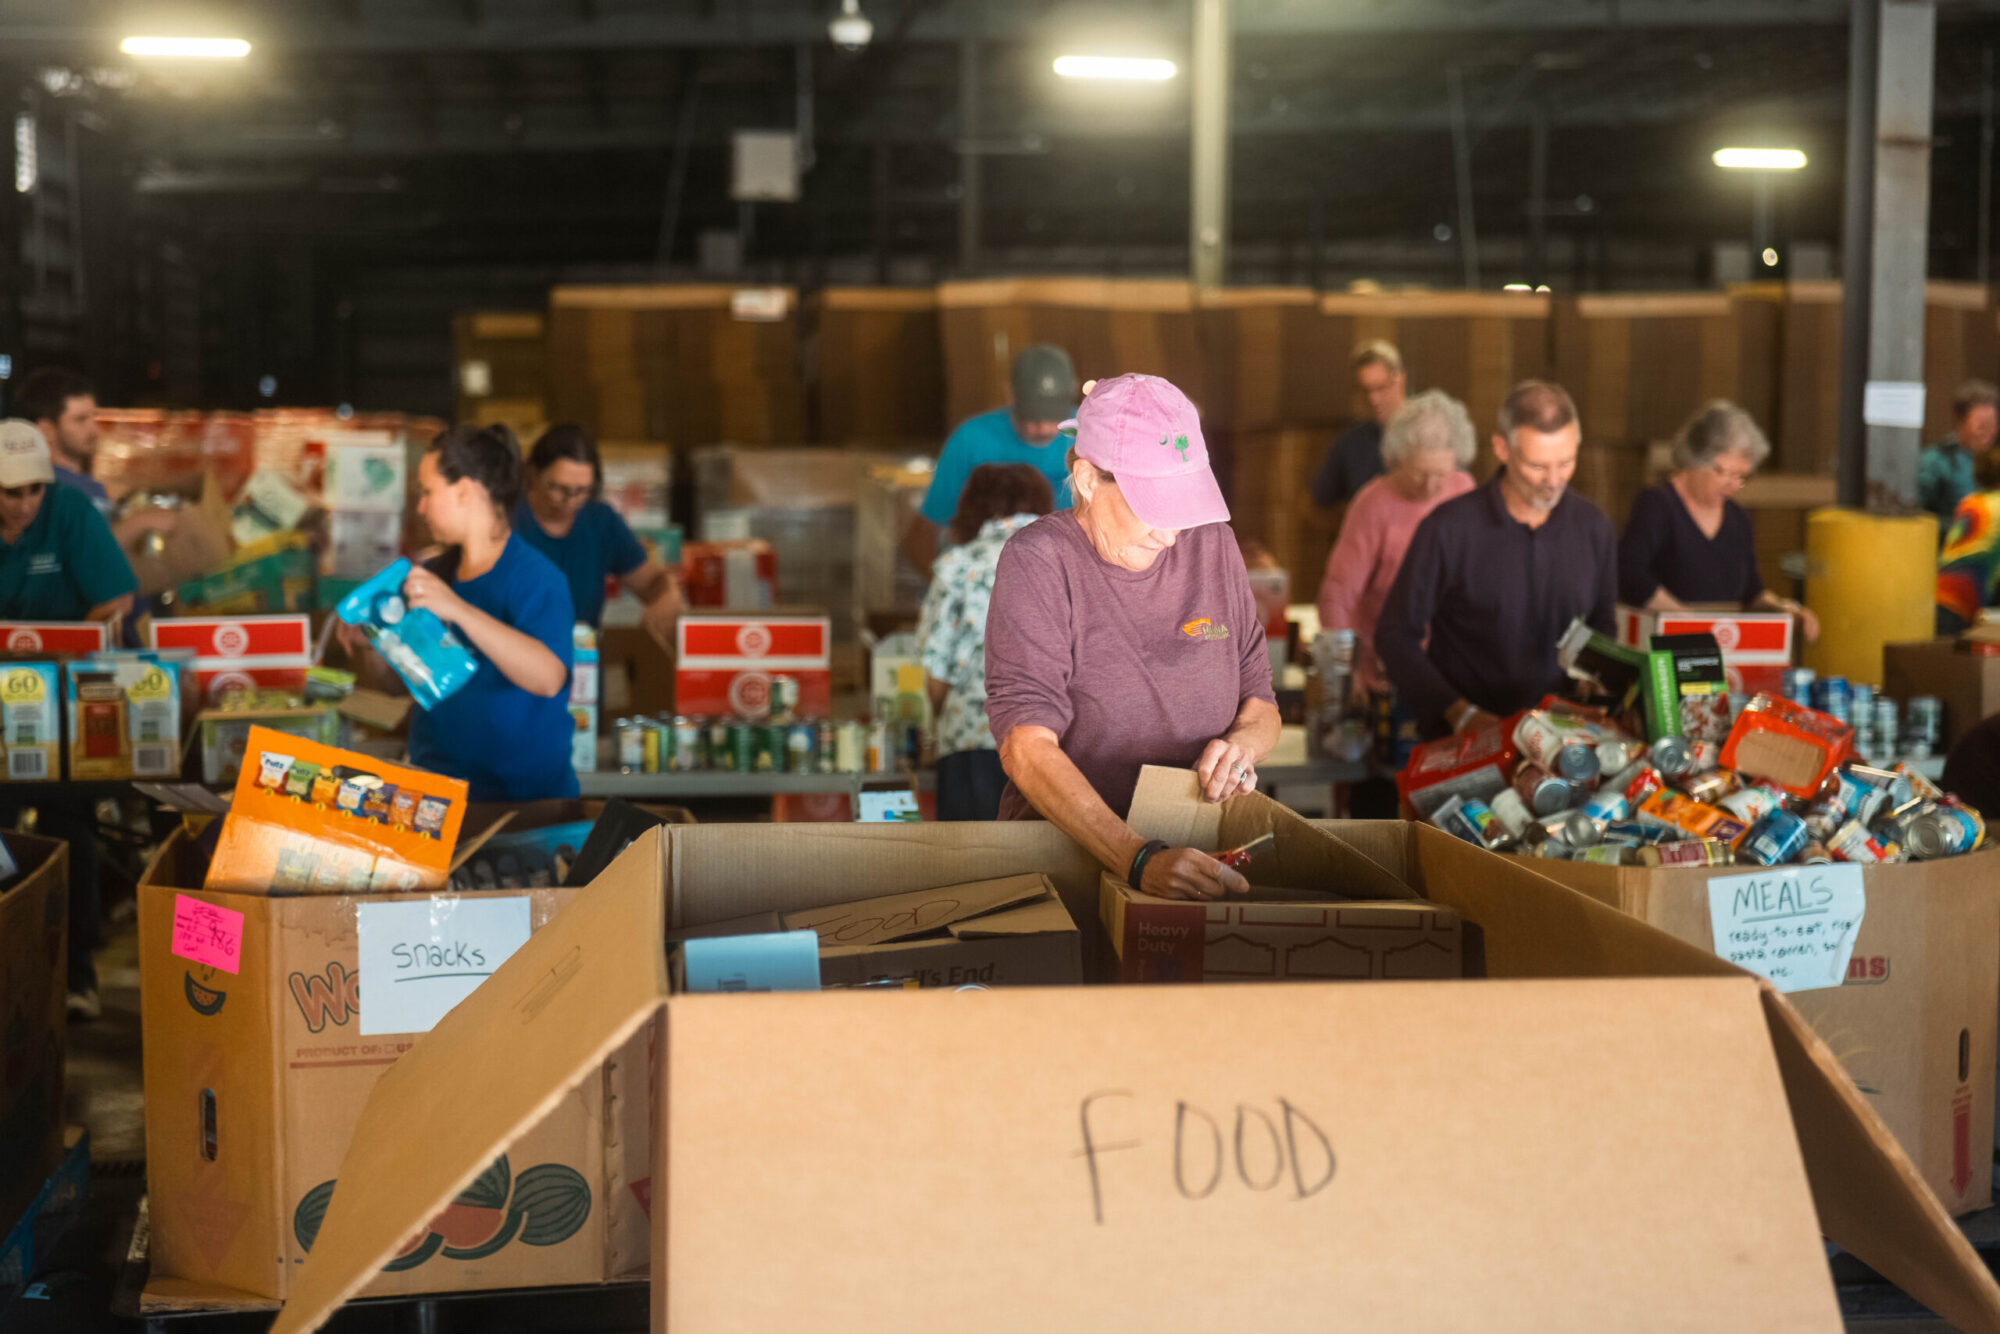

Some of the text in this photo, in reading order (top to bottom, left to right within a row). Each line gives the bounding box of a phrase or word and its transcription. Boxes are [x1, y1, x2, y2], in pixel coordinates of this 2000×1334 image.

[1732, 876, 1834, 917] MEALS
[1138, 921, 1190, 938] Heavy
[1137, 938, 1177, 954] Duty
[948, 961, 996, 986] End
[296, 1046, 358, 1059] PRODUCT
[1070, 1088, 1337, 1226] FOOD
